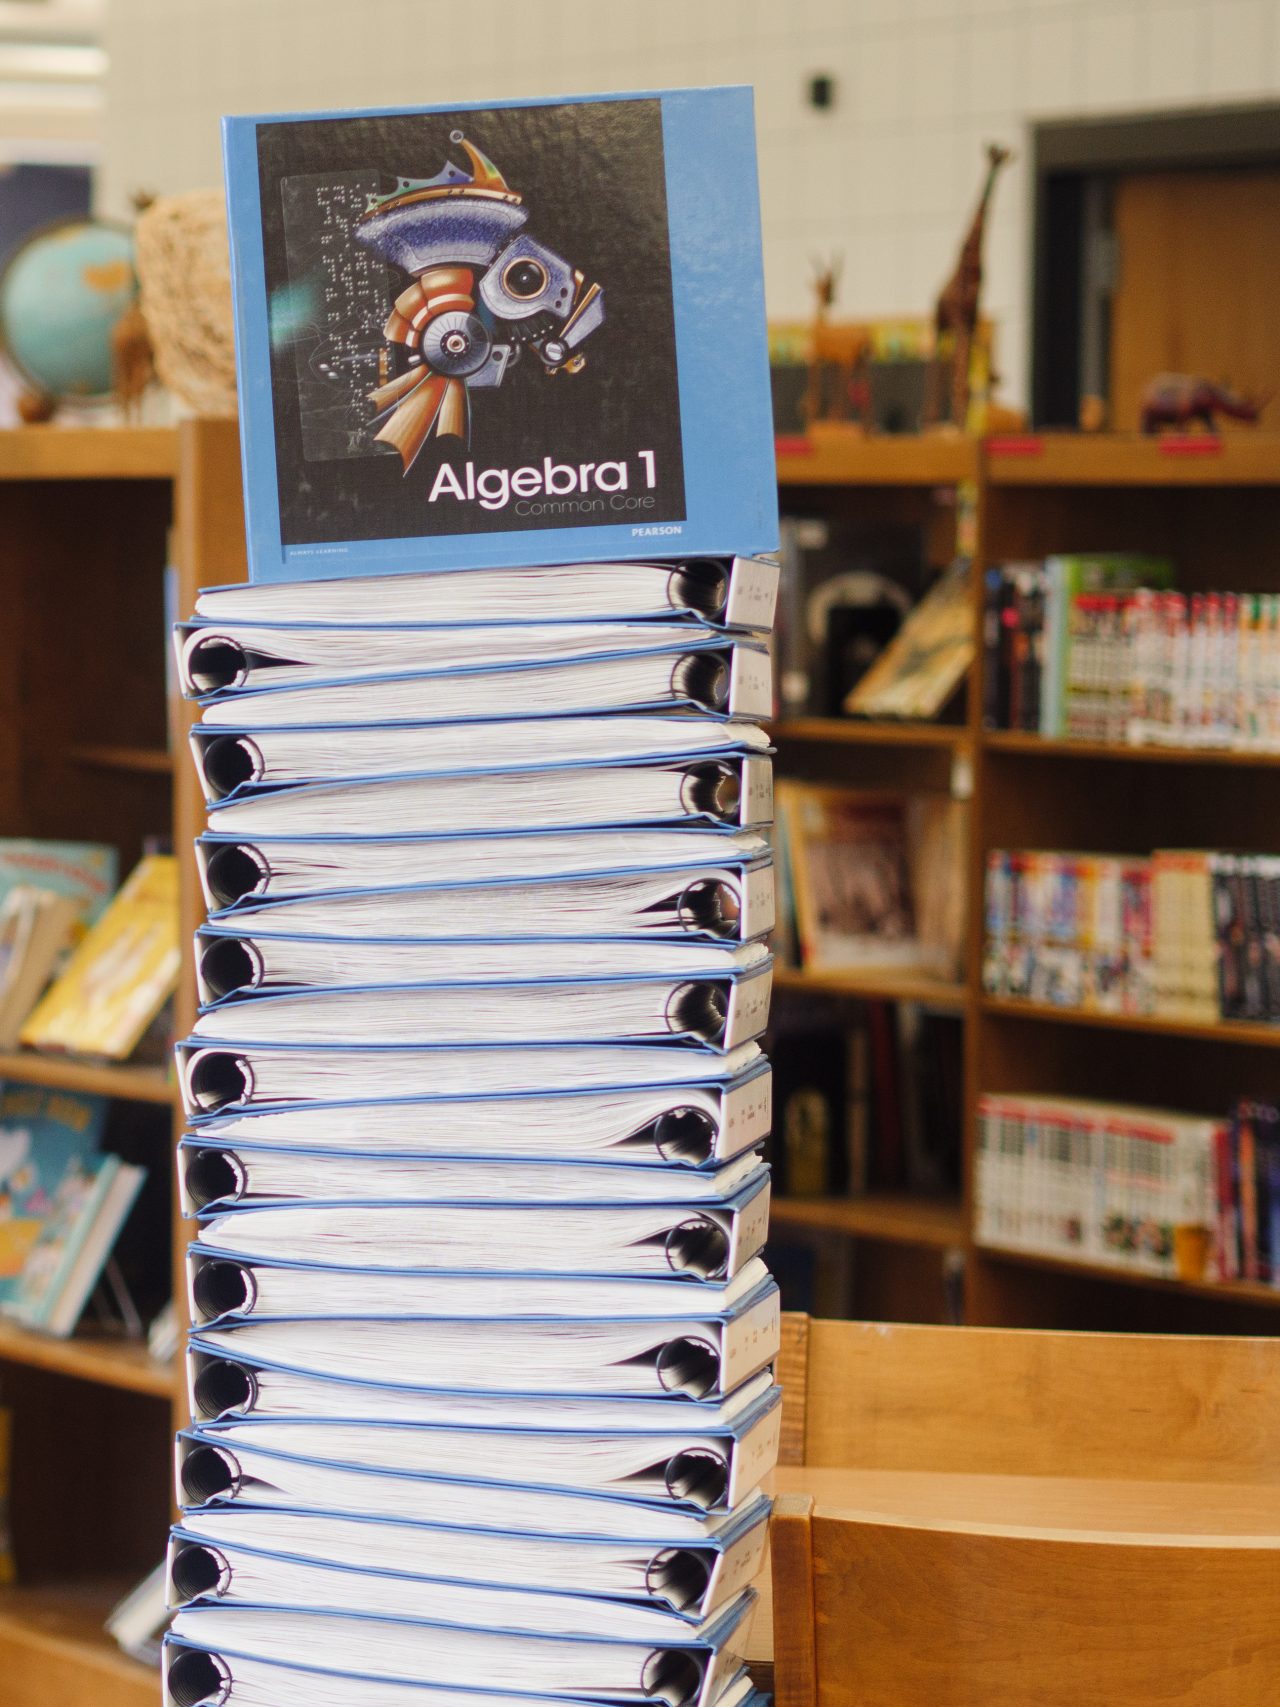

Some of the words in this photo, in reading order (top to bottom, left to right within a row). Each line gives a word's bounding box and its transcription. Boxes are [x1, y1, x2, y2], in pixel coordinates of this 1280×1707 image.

[428, 456, 628, 511] Algebra
[638, 450, 657, 489] 1
[515, 497, 605, 517] Common
[609, 494, 656, 511] Core
[631, 526, 683, 538] PEARSON
